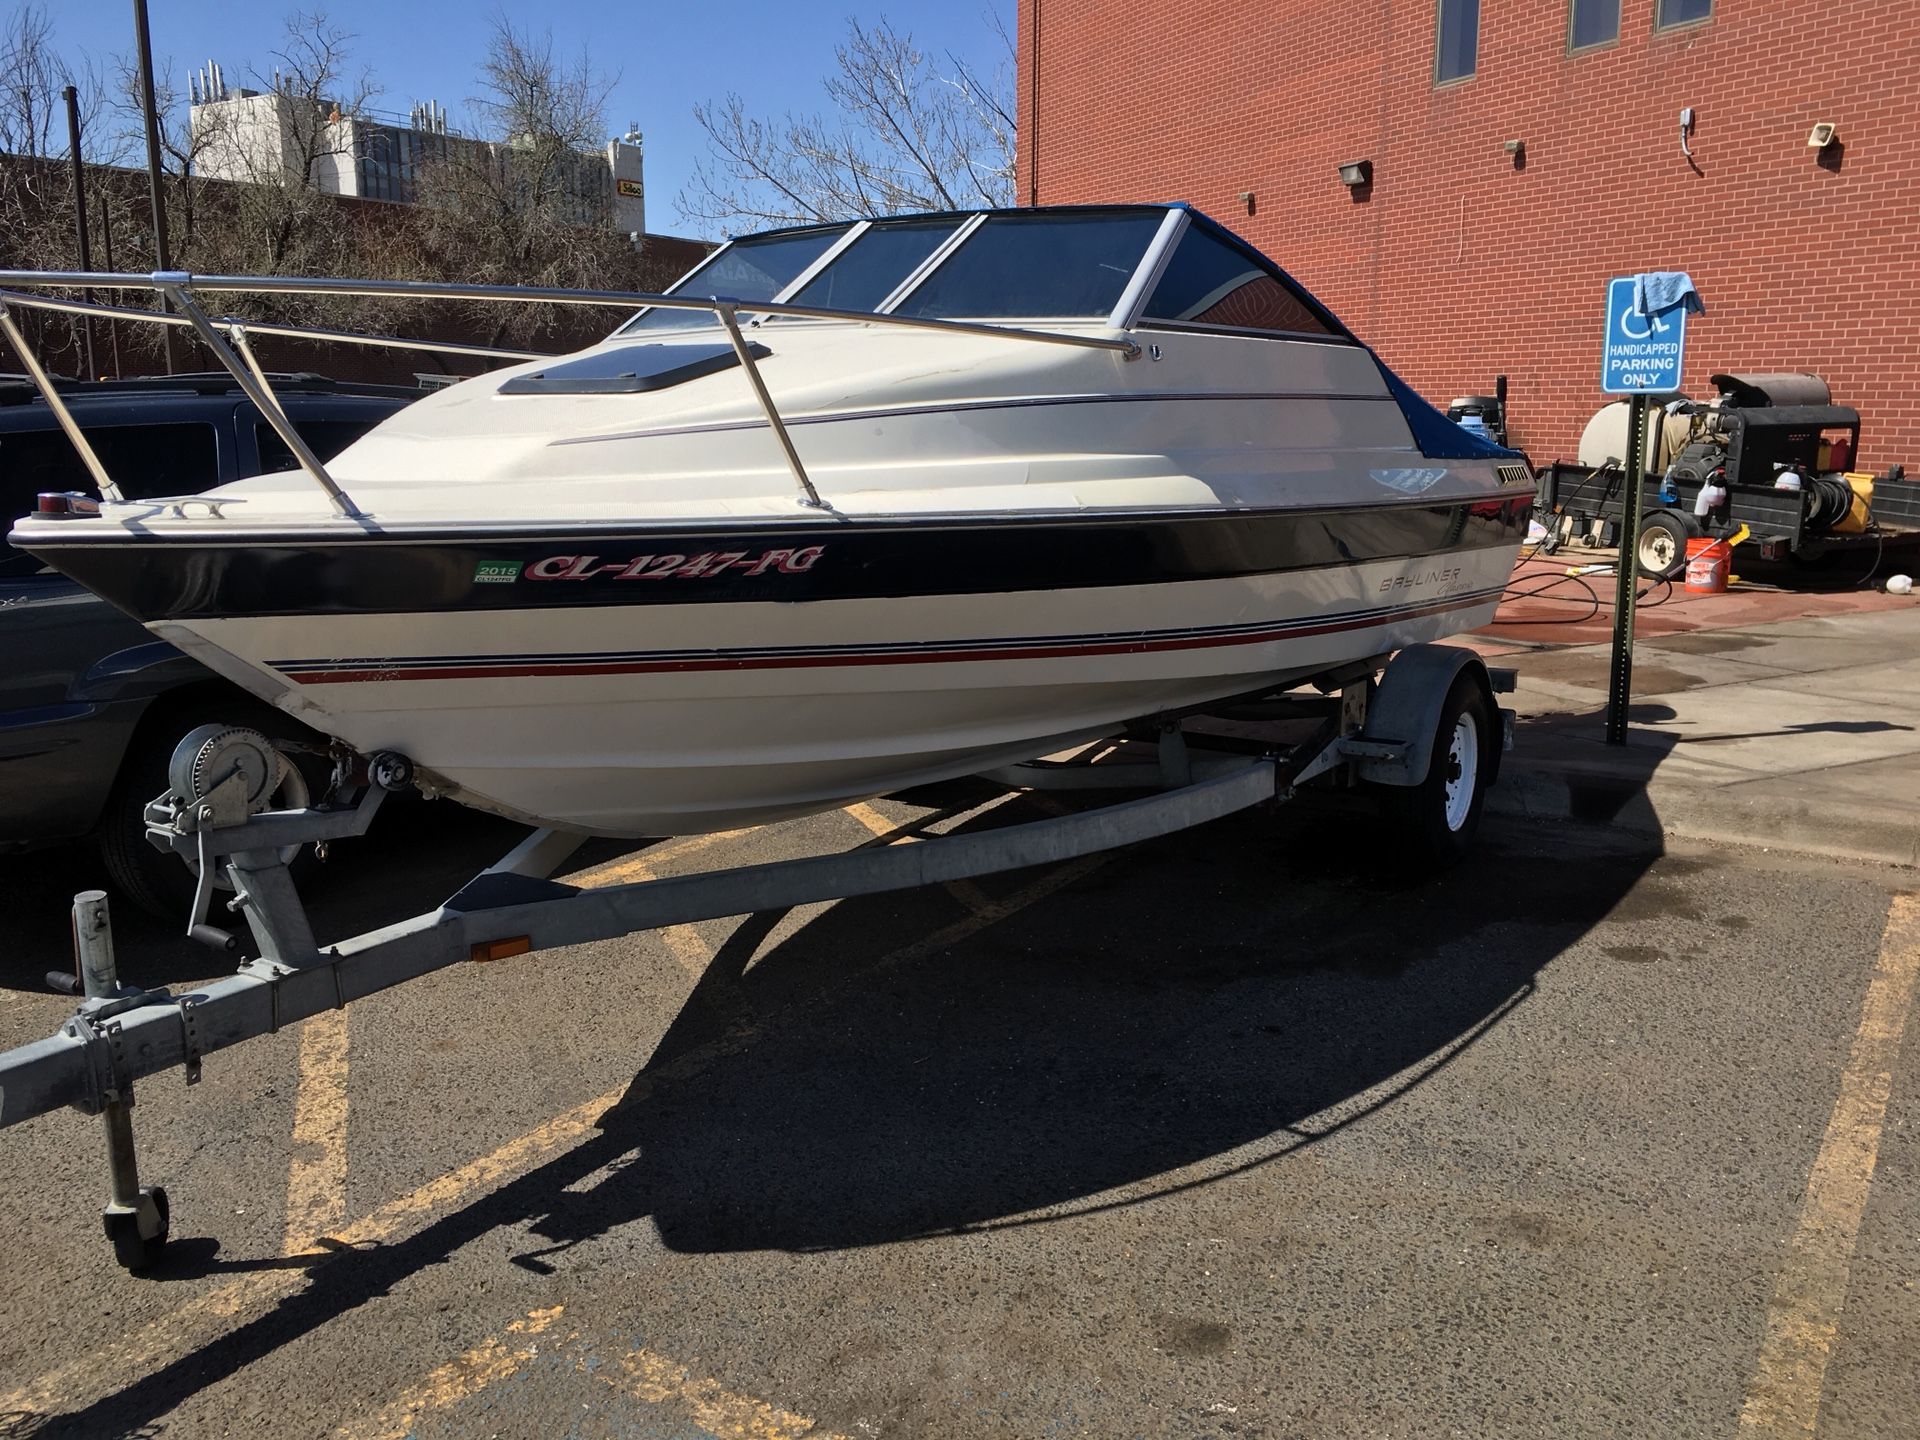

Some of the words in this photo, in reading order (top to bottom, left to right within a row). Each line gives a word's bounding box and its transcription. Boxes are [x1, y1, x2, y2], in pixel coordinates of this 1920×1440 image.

[1610, 343, 1678, 356] HANDICAPPED
[1611, 358, 1674, 371] PARKING
[1622, 373, 1660, 387] ONLY
[525, 545, 827, 581] CL-1247-FG
[479, 567, 518, 575] 2015
[1379, 568, 1461, 592] BAYLINER
